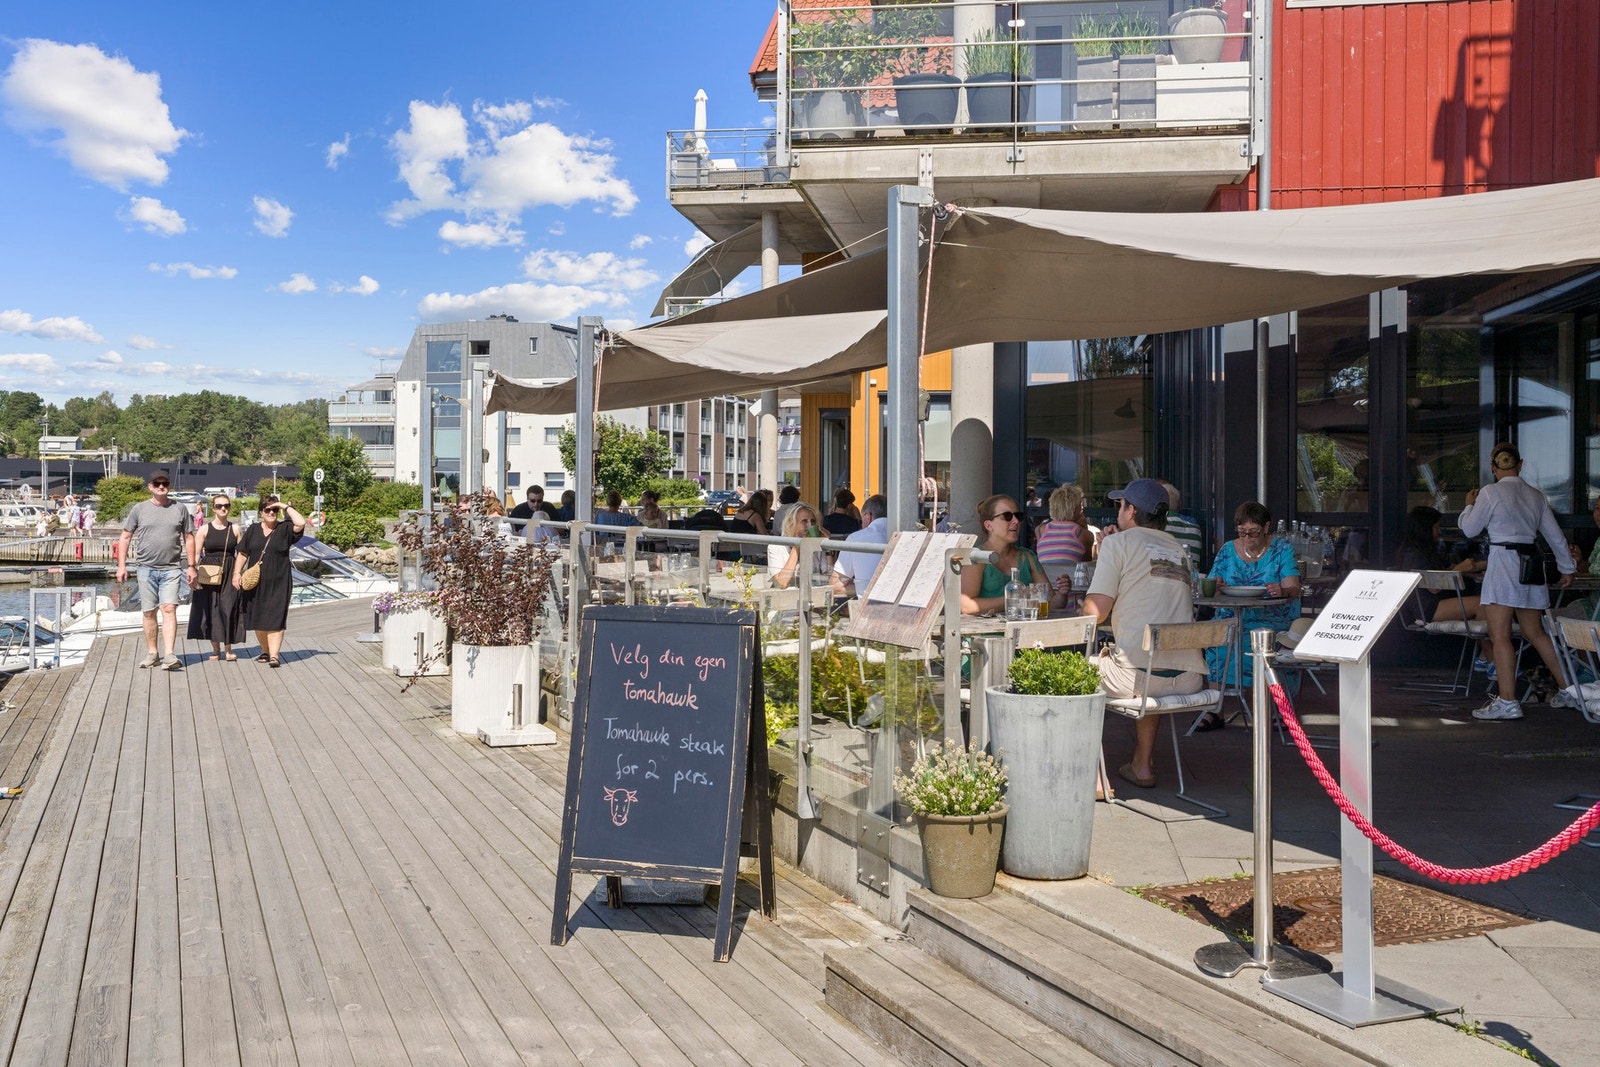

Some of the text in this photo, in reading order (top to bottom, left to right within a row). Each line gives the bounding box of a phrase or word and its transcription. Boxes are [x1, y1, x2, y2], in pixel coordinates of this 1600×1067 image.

[316, 471, 322, 480] B
[1330, 623, 1361, 631] VENT PÅ
[1331, 612, 1374, 622] VENNLIGST
[1314, 632, 1364, 642] PERSONALET
[610, 642, 726, 682] Velg din egen
[623, 679, 699, 710] tomahawk
[603, 717, 726, 757] Tomahawk steak
[615, 752, 714, 794] for 2 pers.
